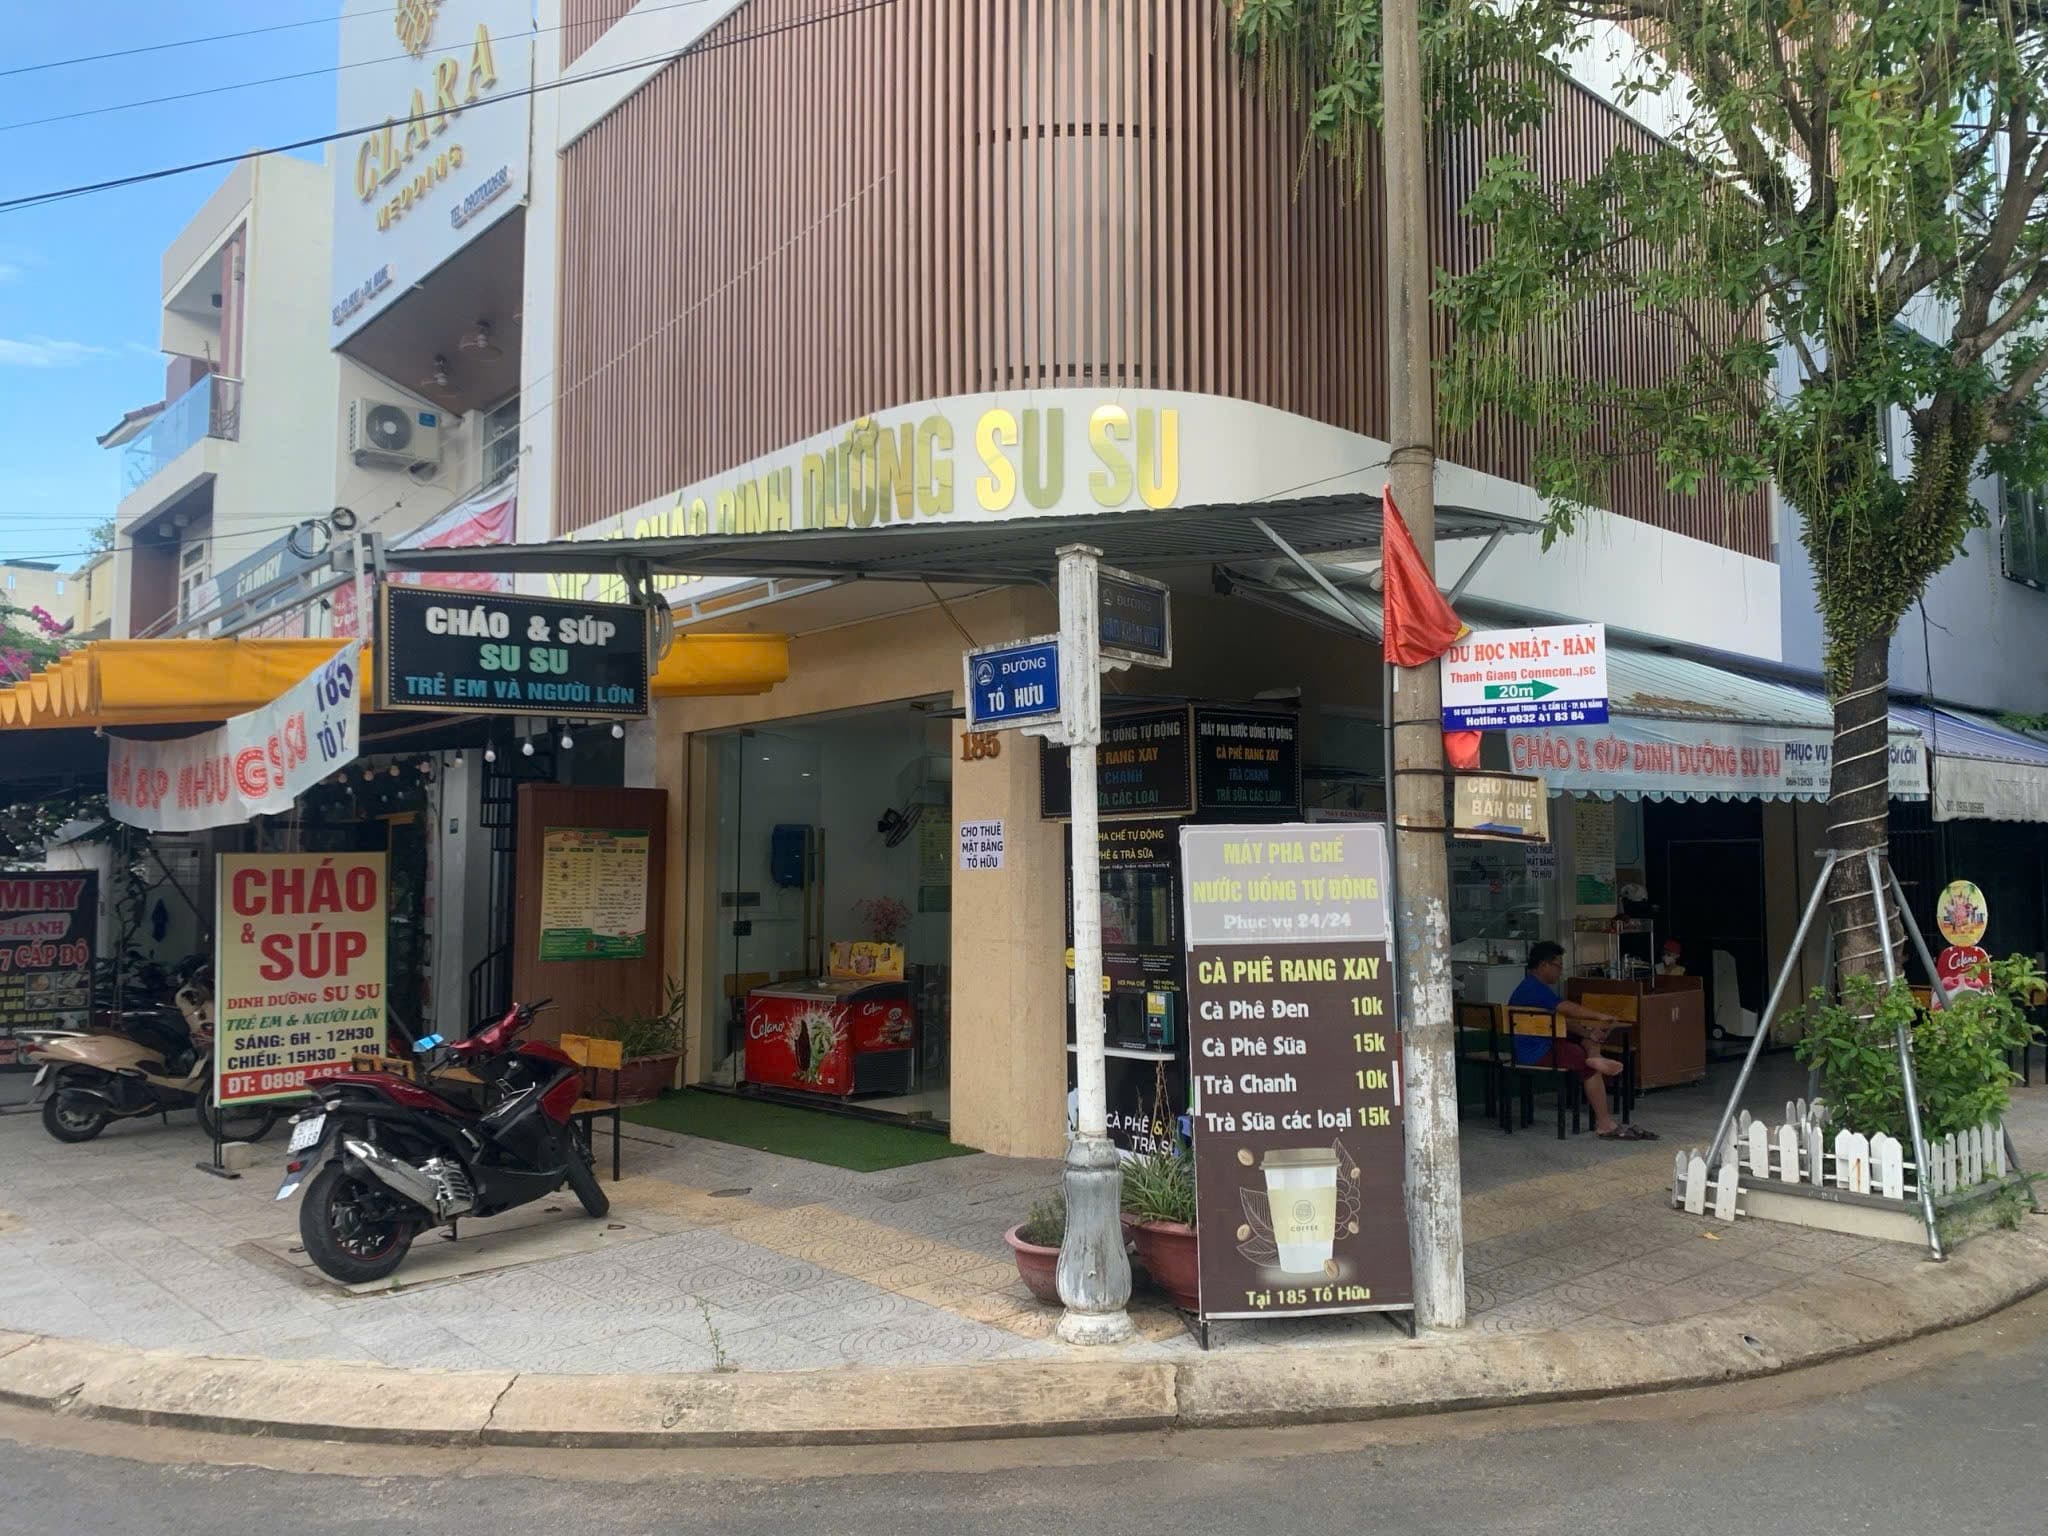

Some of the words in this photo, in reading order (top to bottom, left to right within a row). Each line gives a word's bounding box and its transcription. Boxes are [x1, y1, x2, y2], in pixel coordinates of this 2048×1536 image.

[356, 23, 496, 201] CLARA
[377, 144, 464, 231] WEDDING
[802, 416, 954, 529] DƯỠNG
[976, 408, 1065, 511] SU
[1088, 404, 1180, 510] SU
[425, 605, 510, 639] CHÁO
[527, 616, 551, 642] &
[558, 615, 616, 646] SÚP
[479, 644, 521, 672] SU
[529, 647, 569, 675] SU
[1449, 646, 1470, 663] DU
[1474, 643, 1504, 665] HỌC
[1508, 635, 1551, 663] NHẬT
[1002, 656, 1047, 675] ĐƯỜNG
[1450, 671, 1482, 683] Thanh
[1486, 670, 1517, 684] Giang
[405, 672, 447, 697] TRẺ
[453, 679, 488, 698] EM
[493, 676, 522, 700] VÀ
[527, 680, 591, 702] NGƯỜI
[596, 683, 635, 705] LỚN
[988, 683, 1005, 712] TỐ
[1499, 685, 1534, 698] 20m
[1154, 720, 1181, 740] ĐỘNG
[1216, 724, 1230, 737] PHA
[1466, 716, 1507, 726] Hotline:
[1509, 714, 1536, 724] 0932
[1539, 713, 1551, 722] 41
[960, 730, 1001, 762] 185
[1105, 751, 1135, 765] RANG
[1138, 747, 1159, 763] XAY
[1511, 728, 1572, 770] CHÁO
[1575, 737, 1592, 771] &
[1593, 734, 1629, 774] SÚP
[1633, 742, 1673, 773] DINH
[1678, 737, 1737, 776] DƯỠNG
[1740, 746, 1760, 777] SU
[1762, 748, 1781, 778] SU
[1784, 744, 1813, 767] PHỤC
[1815, 747, 1828, 768] VỤ
[1105, 769, 1143, 784] CHANH
[1467, 778, 1502, 794] CHO
[960, 826, 978, 837] CHO
[979, 821, 1001, 836] THUÊ
[1110, 829, 1126, 841] CHẾ
[1127, 830, 1138, 842] TỰ
[1140, 828, 1165, 840] ĐỘNG
[967, 854, 978, 868] TỐ
[1112, 850, 1119, 860] &
[1119, 848, 1136, 859] TRÀ
[1137, 847, 1154, 859] SỮA
[1224, 839, 1262, 864] MÁY
[1268, 841, 1304, 864] PHA
[1310, 833, 1345, 863] CHẾ
[232, 858, 377, 917] CHÁO
[1193, 875, 1242, 903] NƯỚC
[1248, 873, 1297, 902] UỐNG
[1302, 877, 1325, 905] TỰ
[1329, 872, 1379, 905] ĐỘNG
[240, 922, 255, 944] &
[1223, 912, 1267, 931] Phục
[1272, 915, 1293, 930] vụ
[0, 949, 12, 971] 7
[15, 936, 57, 968] CẤP
[59, 938, 89, 971] ĐỘ
[259, 922, 367, 981] SÚP
[1198, 956, 1227, 983] CÀ
[1233, 955, 1274, 983] PHÊ
[1280, 958, 1336, 982] RANG
[1343, 957, 1380, 981] XAY
[227, 996, 264, 1010] DINH
[267, 990, 317, 1006] DƯỠNG
[323, 985, 350, 1003] SU
[355, 983, 381, 1000] SU
[1200, 1000, 1224, 1020] Cà
[1229, 999, 1265, 1020] Phê
[1271, 1000, 1309, 1019] Đen
[1351, 997, 1384, 1016] 10k
[225, 1012, 256, 1032] TRẺ
[259, 1015, 283, 1030] EM
[286, 1013, 299, 1028] &
[302, 1007, 350, 1025] NGƯỜI
[750, 1013, 785, 1039] Celano
[235, 1032, 285, 1051] SÁNG:
[290, 1031, 310, 1046] 6H
[326, 1026, 375, 1043] 12H30
[1201, 1037, 1225, 1057] Cà
[1231, 1037, 1267, 1057] Phê
[1273, 1036, 1307, 1055] Sữa
[1353, 1033, 1386, 1053] 15k
[287, 1046, 336, 1064] 15H30
[228, 1076, 255, 1094] ĐT:
[261, 1069, 305, 1091] 0898
[1204, 1075, 1234, 1094] Trà
[1240, 1074, 1297, 1093] Chanh
[1356, 1069, 1389, 1090] 10k
[1105, 1110, 1121, 1129] CÀ
[1124, 1115, 1149, 1133] PHÊ
[1153, 1121, 1163, 1136] &
[1205, 1112, 1236, 1132] Trà
[1242, 1111, 1276, 1131] Sữa
[1282, 1110, 1312, 1129] các
[1318, 1107, 1352, 1132] loại
[1358, 1107, 1391, 1127] 15k
[1246, 1290, 1271, 1309] Tại
[1277, 1289, 1307, 1304] 185
[1312, 1284, 1333, 1302] Tố
[1337, 1285, 1371, 1300] Hữu
